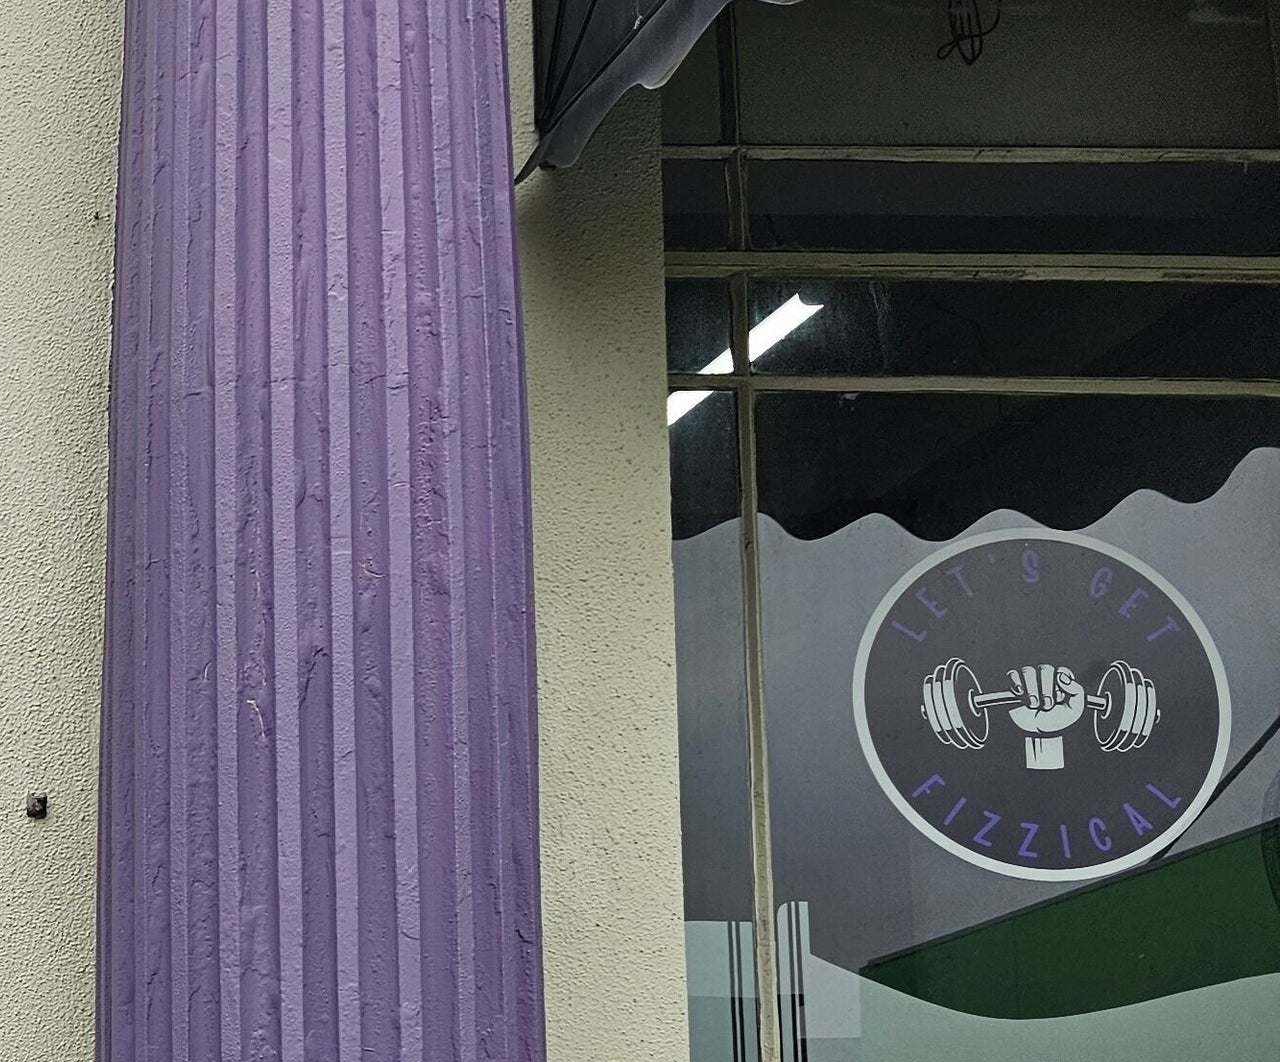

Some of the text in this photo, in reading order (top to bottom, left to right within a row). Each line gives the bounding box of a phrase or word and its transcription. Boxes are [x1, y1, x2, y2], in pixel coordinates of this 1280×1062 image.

[891, 549, 1181, 642] LET'S GET
[911, 773, 1182, 859] FIZZICAL
